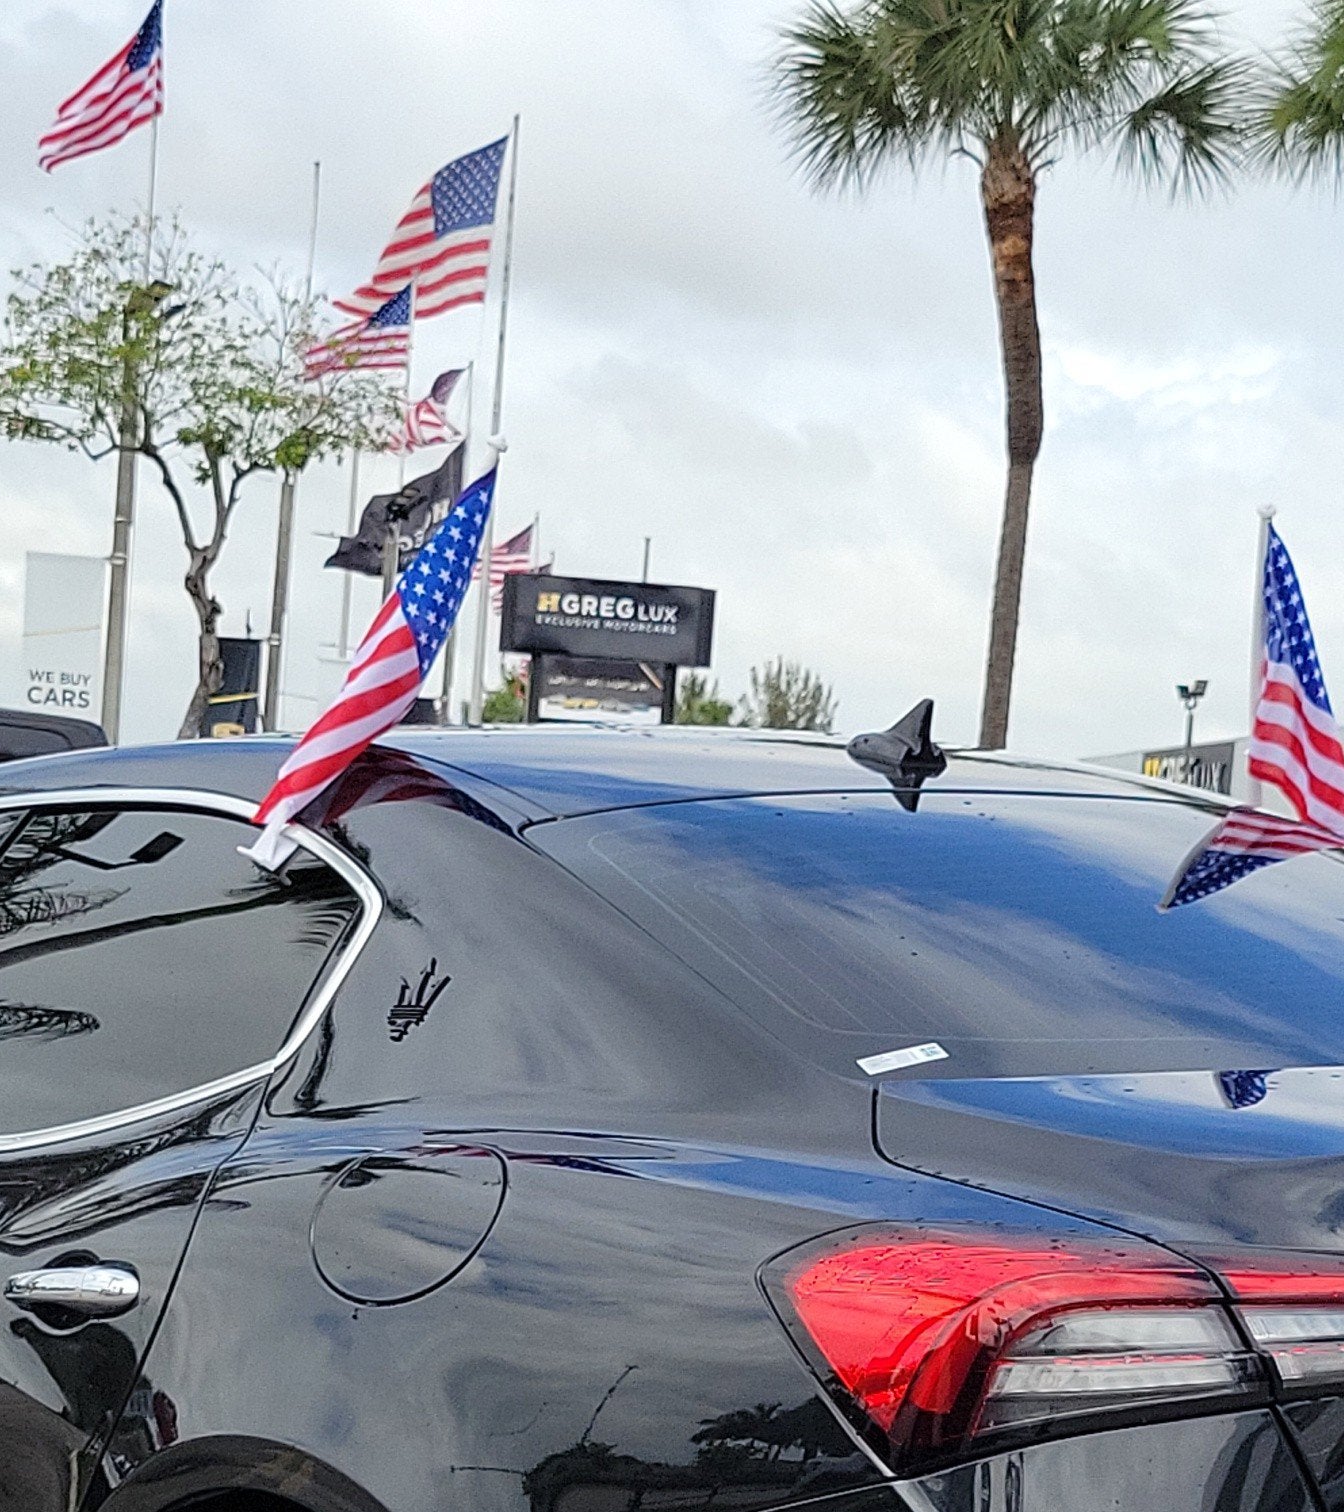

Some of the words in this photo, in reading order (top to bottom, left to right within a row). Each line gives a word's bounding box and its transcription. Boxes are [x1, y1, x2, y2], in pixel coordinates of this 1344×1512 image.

[637, 602, 679, 623] LUX
[29, 668, 55, 684] WE
[60, 672, 92, 687] BUY
[27, 686, 90, 709] CARS
